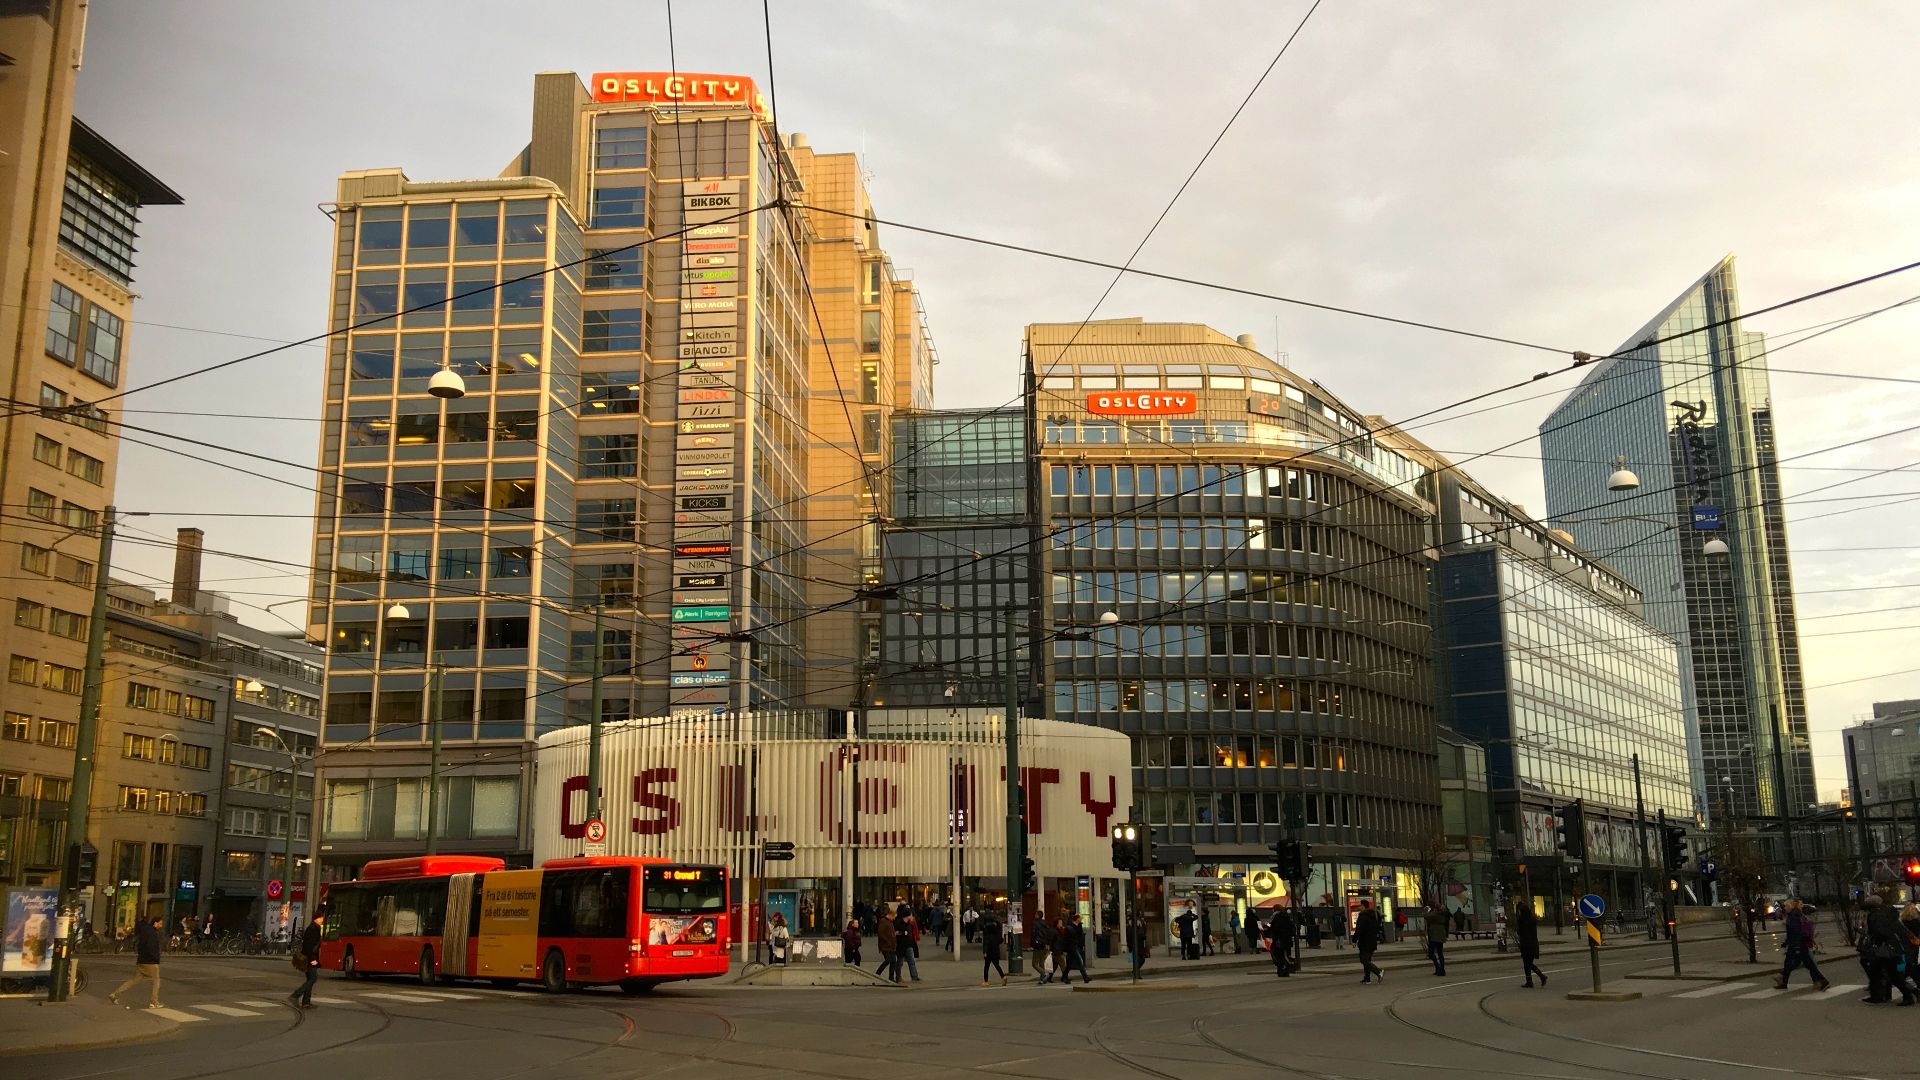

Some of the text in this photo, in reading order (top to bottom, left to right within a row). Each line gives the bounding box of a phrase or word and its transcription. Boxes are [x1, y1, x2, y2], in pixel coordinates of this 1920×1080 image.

[683, 391, 729, 401] LINDEX
[688, 498, 719, 508] KICKS
[688, 560, 716, 569] NIKITA
[674, 675, 694, 684] clas
